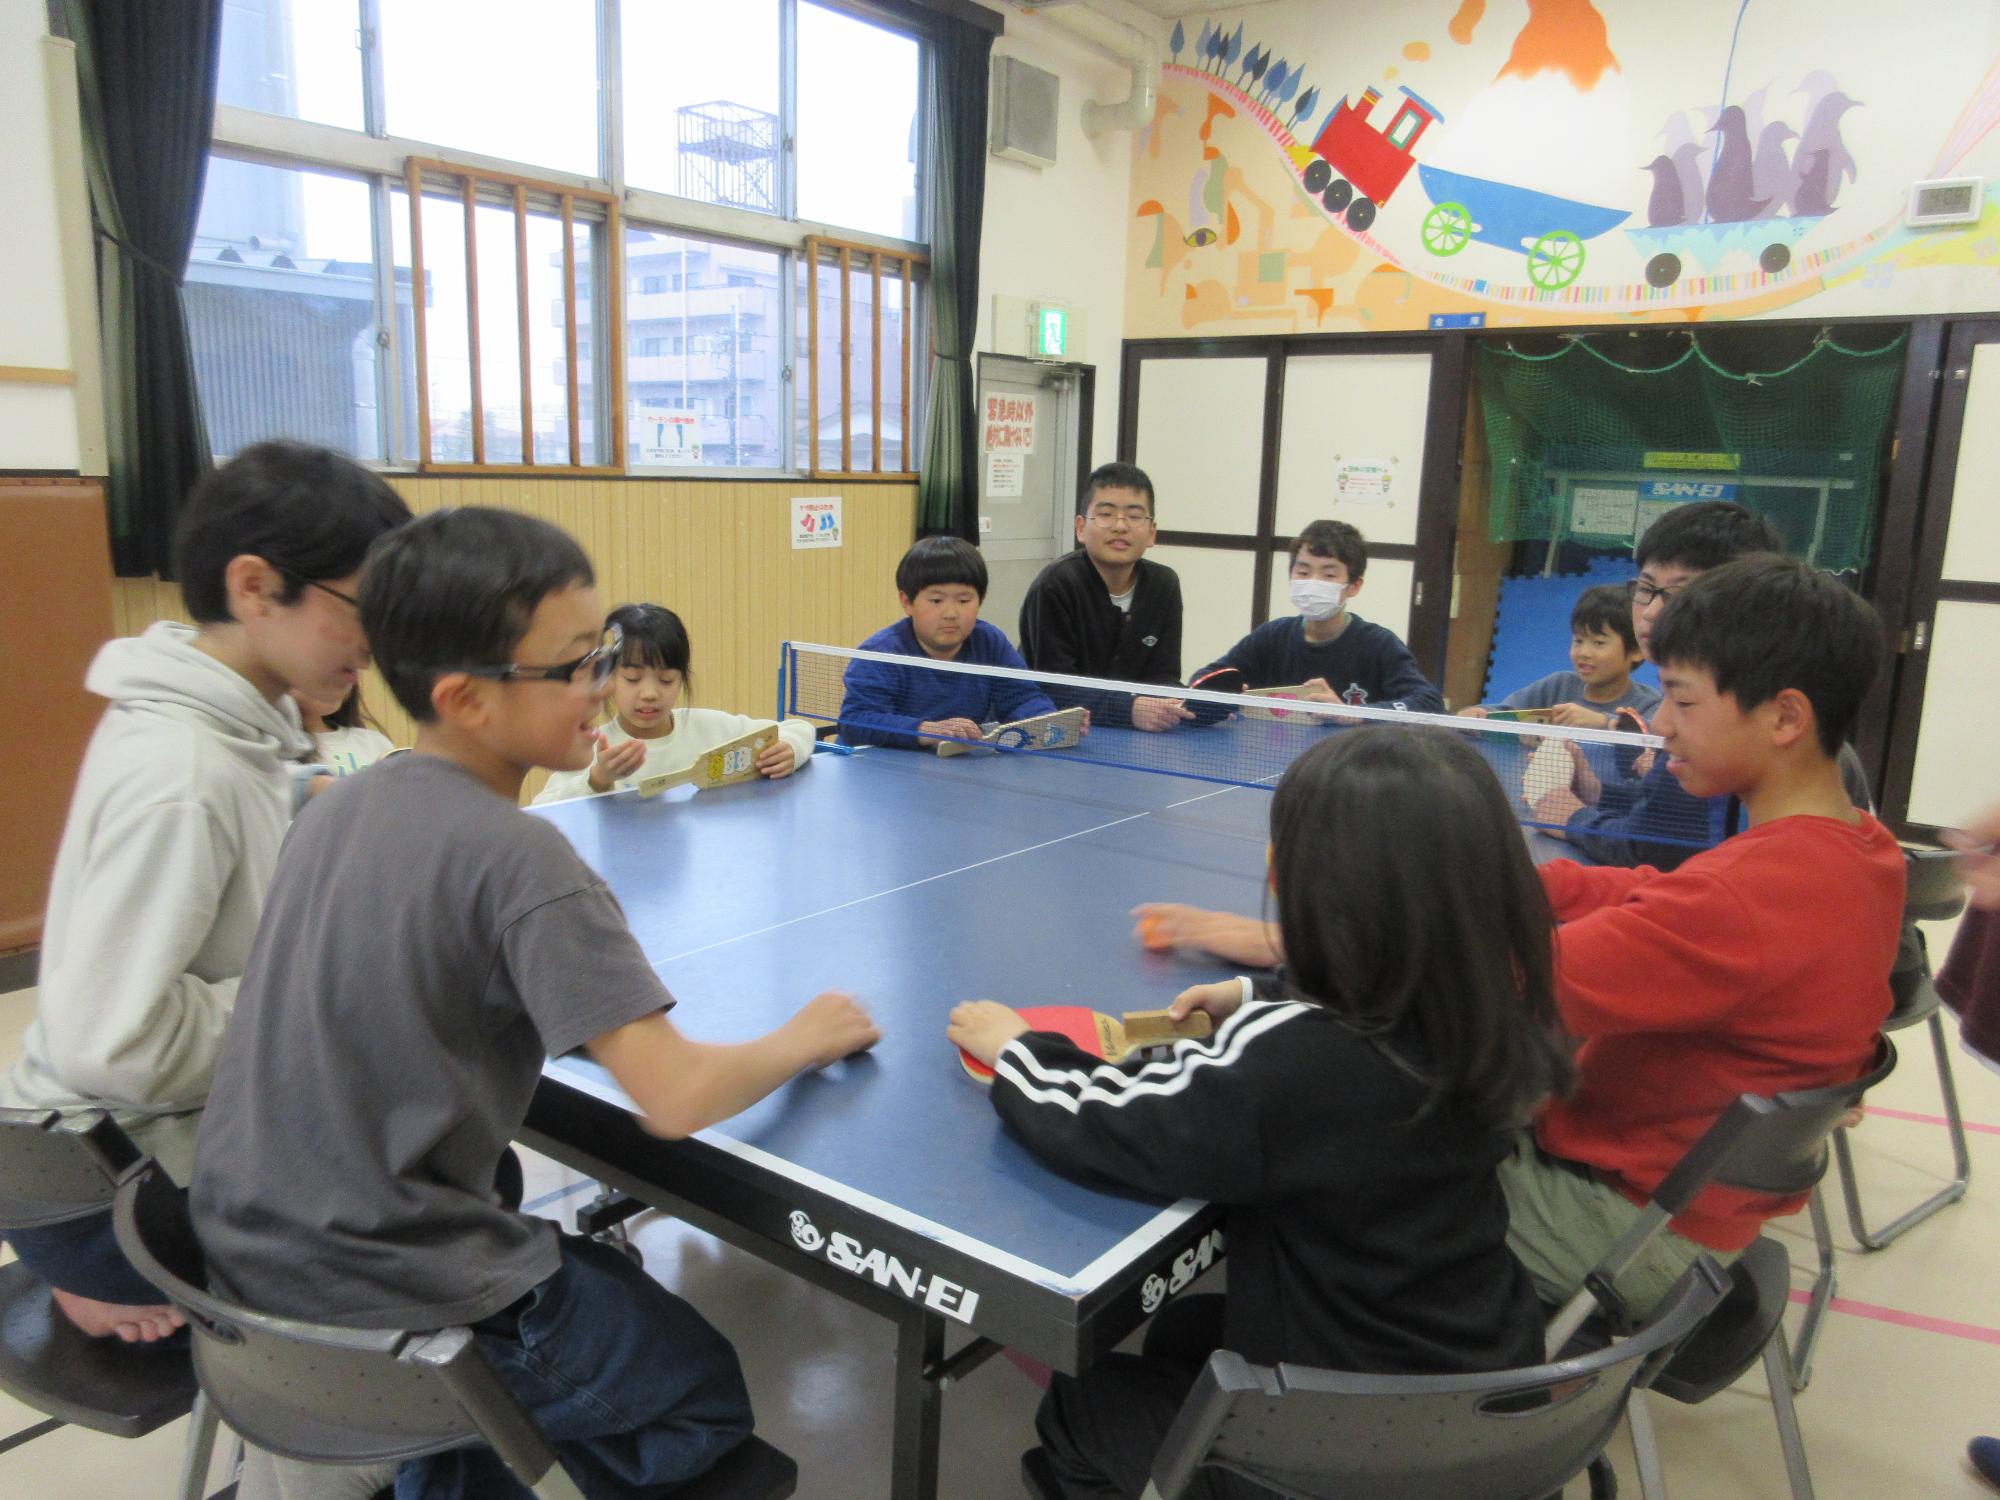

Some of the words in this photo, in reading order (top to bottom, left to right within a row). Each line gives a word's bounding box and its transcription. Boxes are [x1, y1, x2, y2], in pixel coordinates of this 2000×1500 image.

[987, 398, 1034, 422] 緊急時以外
[1652, 482, 1724, 498] SAN-EI
[826, 1231, 980, 1325] SAN-EI
